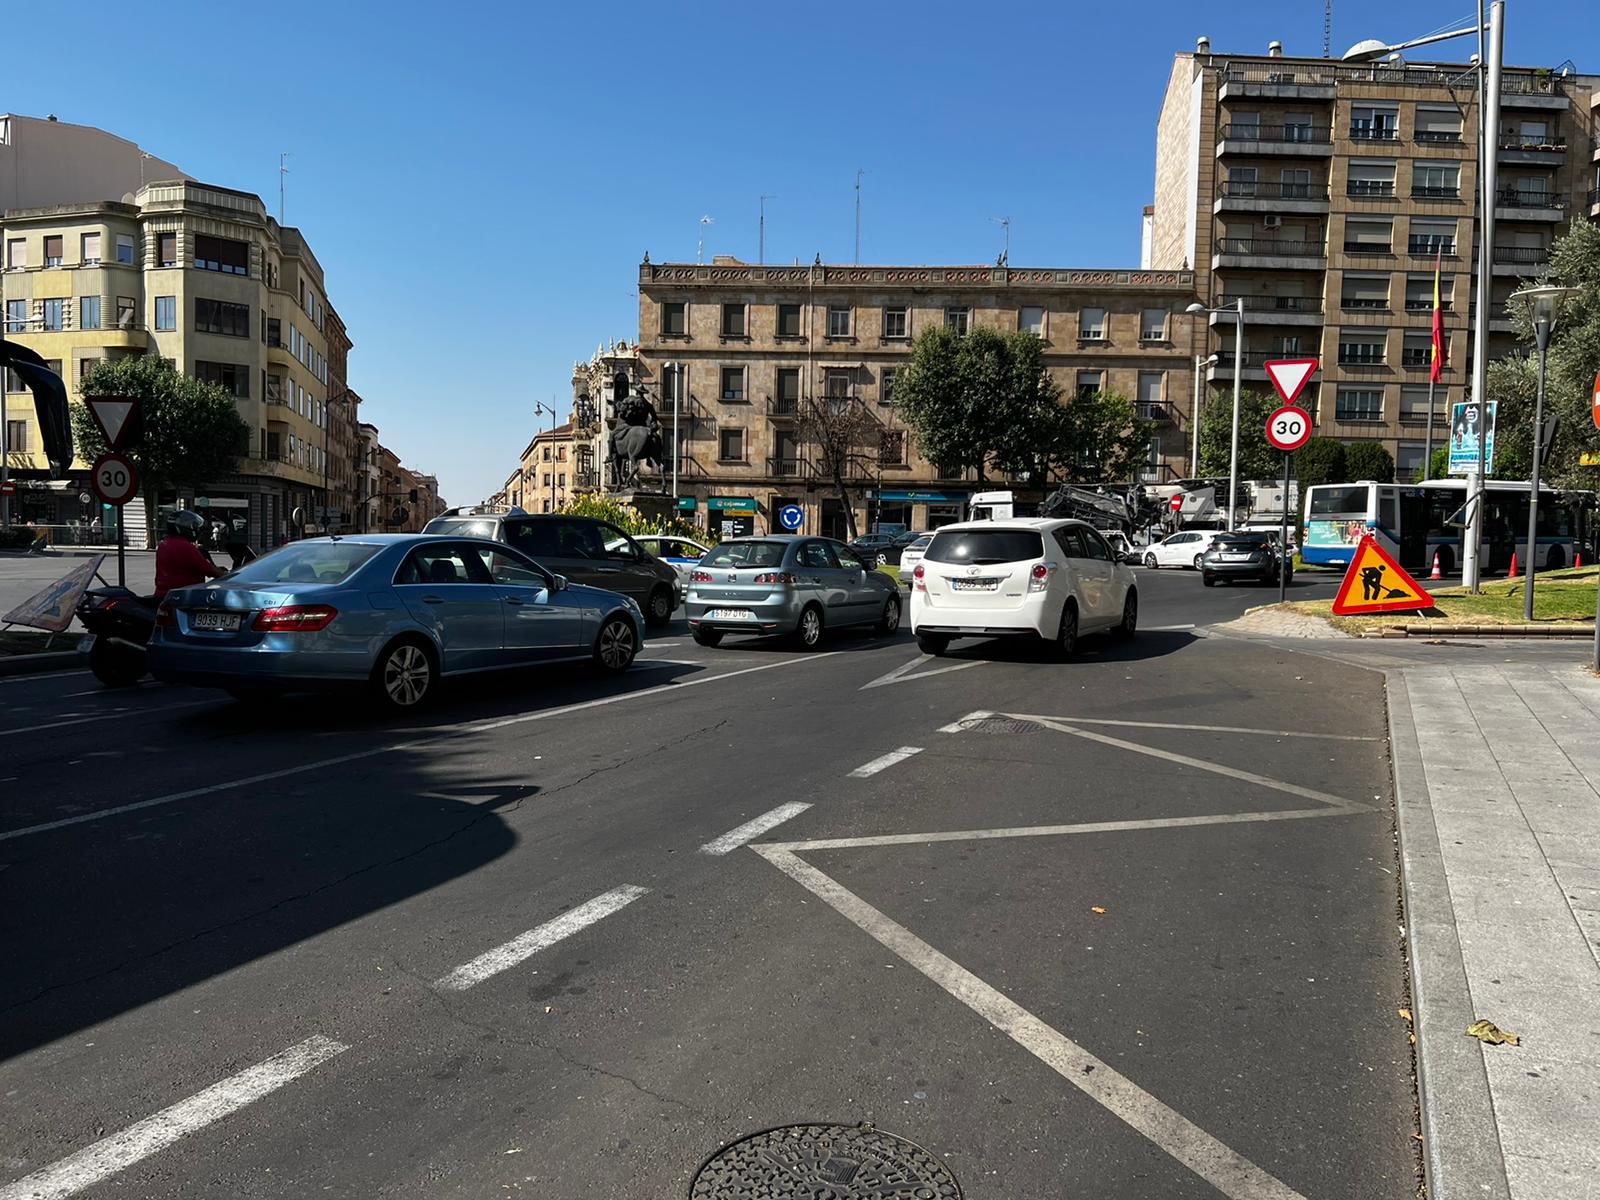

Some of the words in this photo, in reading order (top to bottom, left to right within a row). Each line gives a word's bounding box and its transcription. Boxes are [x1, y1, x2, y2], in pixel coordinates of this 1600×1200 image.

[1276, 420, 1301, 435] 30
[101, 470, 126, 487] 30
[196, 614, 218, 626] 9039
[219, 615, 239, 627] HJF
